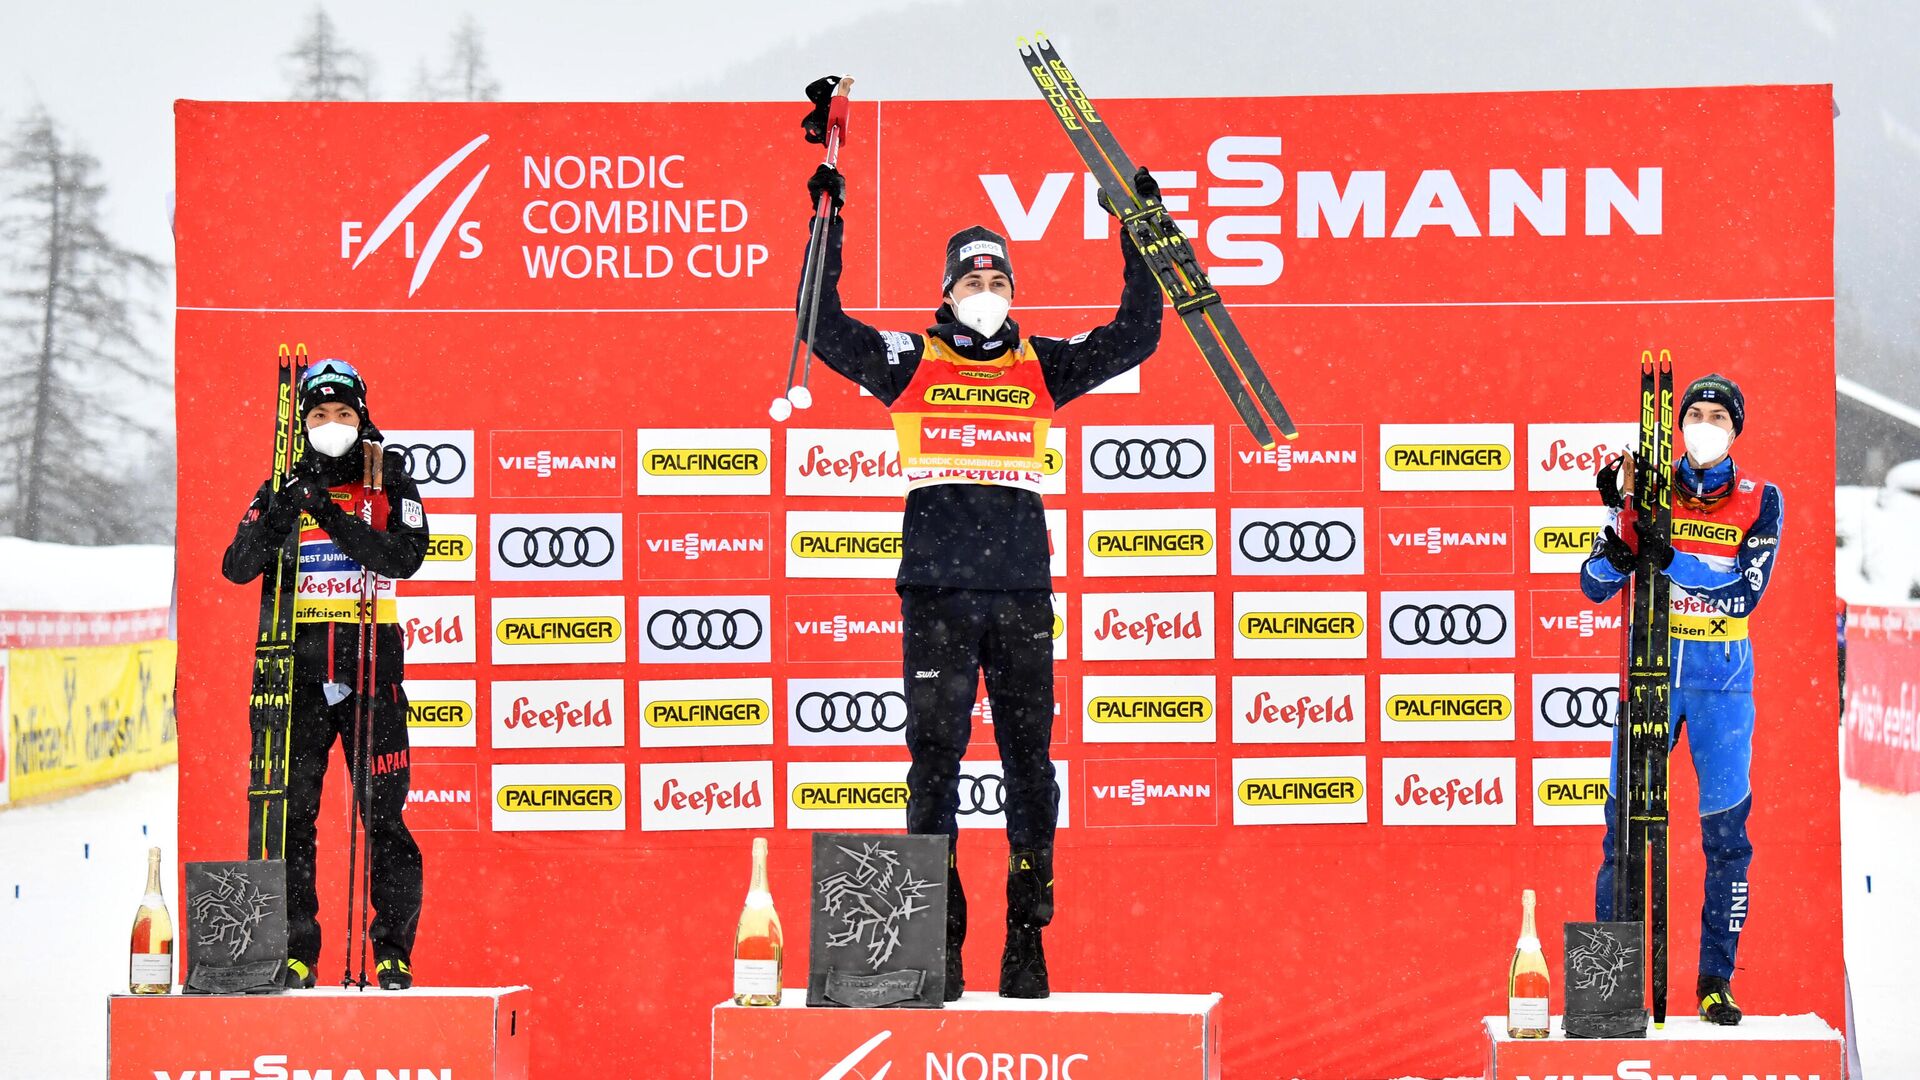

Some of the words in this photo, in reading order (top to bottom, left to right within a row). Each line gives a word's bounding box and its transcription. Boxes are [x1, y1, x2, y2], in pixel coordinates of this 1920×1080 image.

[1032, 64, 1082, 130] FISCHER
[1049, 59, 1102, 123] FISCHER
[523, 155, 685, 189] NORDIC
[522, 200, 748, 234] COMBINED
[522, 246, 674, 279] WORLD
[687, 245, 768, 277] CUP
[931, 387, 1030, 405] PALFINGER
[273, 382, 291, 493] FISCHER
[923, 424, 1032, 448] VIESSMANN
[1659, 389, 1673, 510] FISCHER
[498, 450, 616, 477] VIESSMANN
[651, 453, 758, 471] PALFINGER
[799, 444, 903, 483] Seefeld
[1238, 444, 1357, 472] VIESSMANN
[1394, 449, 1502, 466] PALFINGER
[1541, 439, 1619, 476] Seefe
[1097, 534, 1204, 552] PALFINGER
[1387, 527, 1507, 554] VIESSMANN
[1543, 532, 1598, 549] PALFI
[1672, 522, 1737, 543] LFINGER
[300, 555, 321, 564] BEST
[646, 533, 764, 560] VIESSMANN
[296, 607, 351, 618] aiffeisen
[1247, 617, 1355, 633] PALFINGER
[1540, 609, 1622, 637] VIESSMA
[505, 621, 613, 640] PALFINGER
[1094, 608, 1202, 645] Seefeld
[914, 668, 941, 678] swix
[504, 696, 613, 733] Seefeld
[653, 703, 761, 722] PALFINGER
[1097, 701, 1204, 718] PALFINGER
[1245, 691, 1353, 729] Seefeld
[1395, 700, 1502, 716] PALFINGER
[506, 789, 613, 806] PALFINGER
[653, 778, 762, 815] Seefeld
[801, 787, 908, 804] PALFINGER
[1092, 778, 1211, 806] VIESSMANN
[1247, 782, 1355, 801] PALFINGER
[1394, 774, 1504, 811] Seefeld
[1547, 783, 1609, 800] PALFIN
[926, 1051, 1089, 1080] NORDIC
